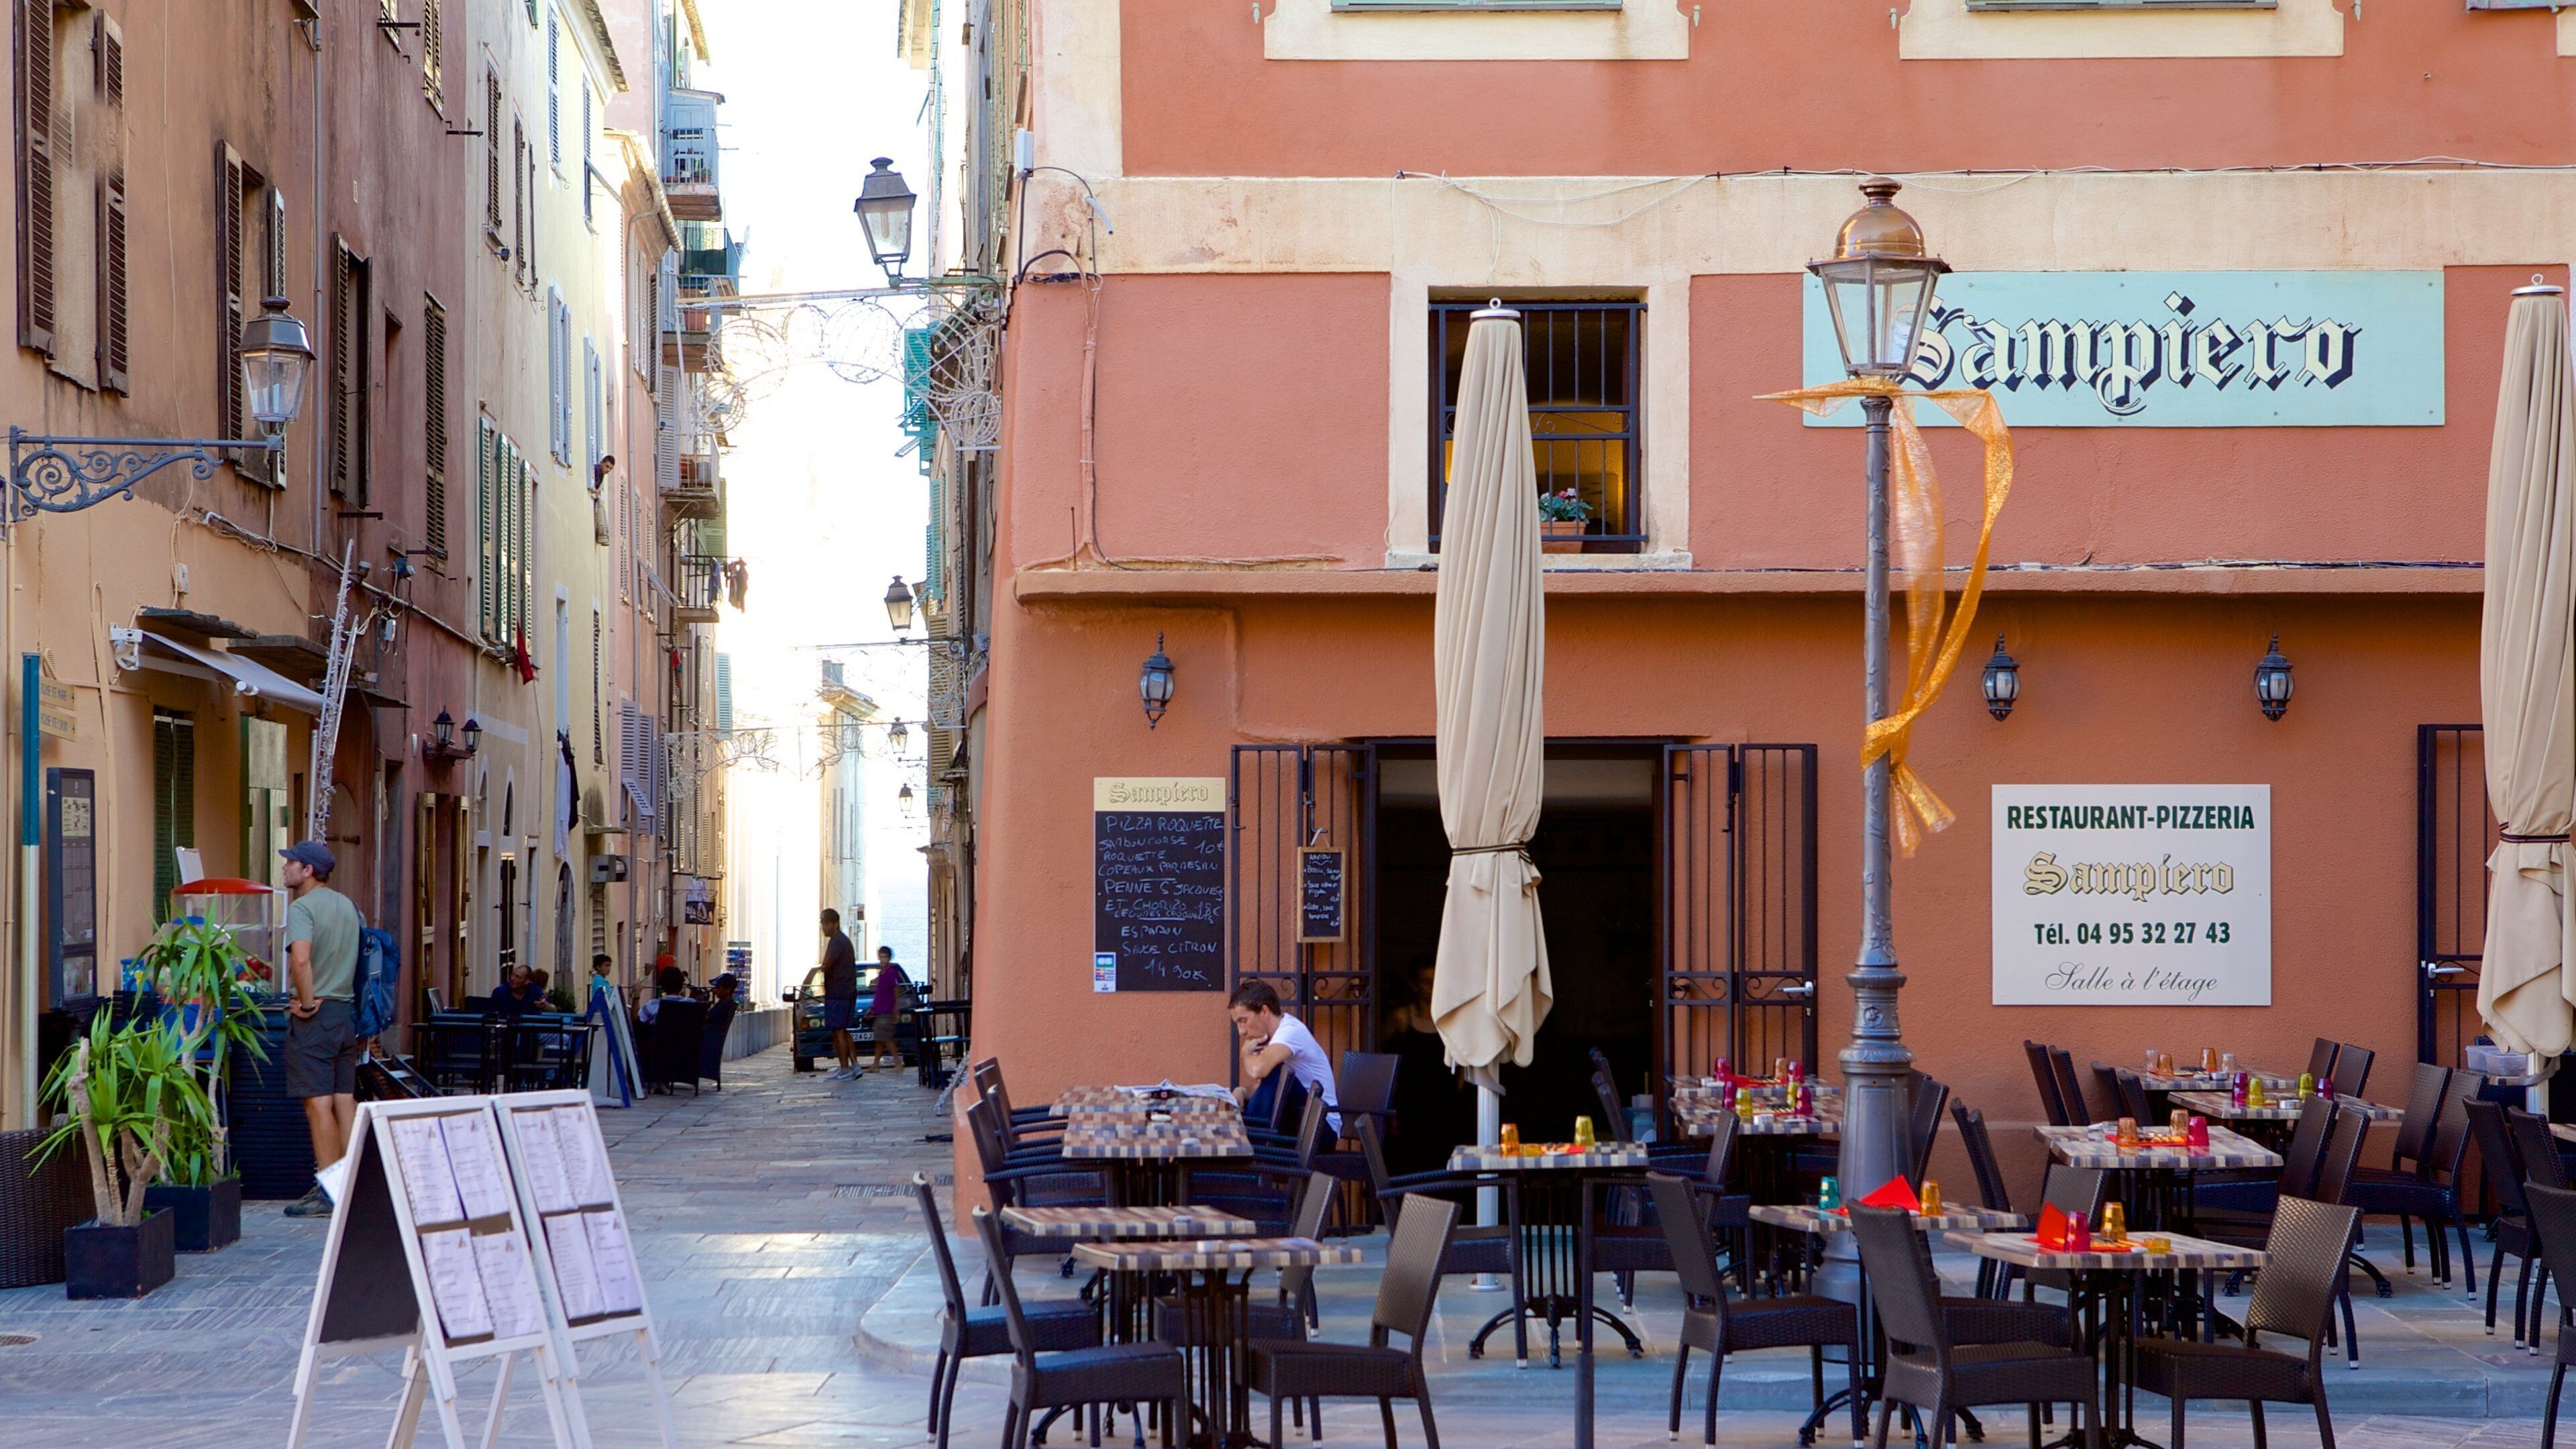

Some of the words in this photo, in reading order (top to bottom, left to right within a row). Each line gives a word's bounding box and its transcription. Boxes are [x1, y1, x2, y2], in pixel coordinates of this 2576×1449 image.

[1109, 782, 1208, 806] Sampiero
[1106, 816, 1152, 833] PIZZA
[1158, 816, 1224, 833] ROQUETTE
[2007, 805, 2255, 829] RESTAURANT-PIZZERIA
[1104, 850, 1167, 862] ROQUETTE
[1098, 864, 1154, 876] COPEAUX
[2023, 851, 2233, 902] Sampiero
[1104, 879, 1152, 894] PENNE
[1105, 899, 1128, 911] ET
[1133, 898, 1187, 911] CHORIZO
[1121, 925, 1182, 939] ESPADON
[2034, 923, 2070, 945] Tél.
[2078, 923, 2102, 945] 04
[2110, 923, 2134, 944] 95
[2141, 922, 2166, 944] 32
[2174, 922, 2196, 944] 27
[2206, 922, 2231, 943] 43
[1167, 941, 1218, 955] CITRON
[2045, 962, 2114, 990] Salle
[2121, 972, 2136, 990] à
[2143, 966, 2218, 1002] l'étage
